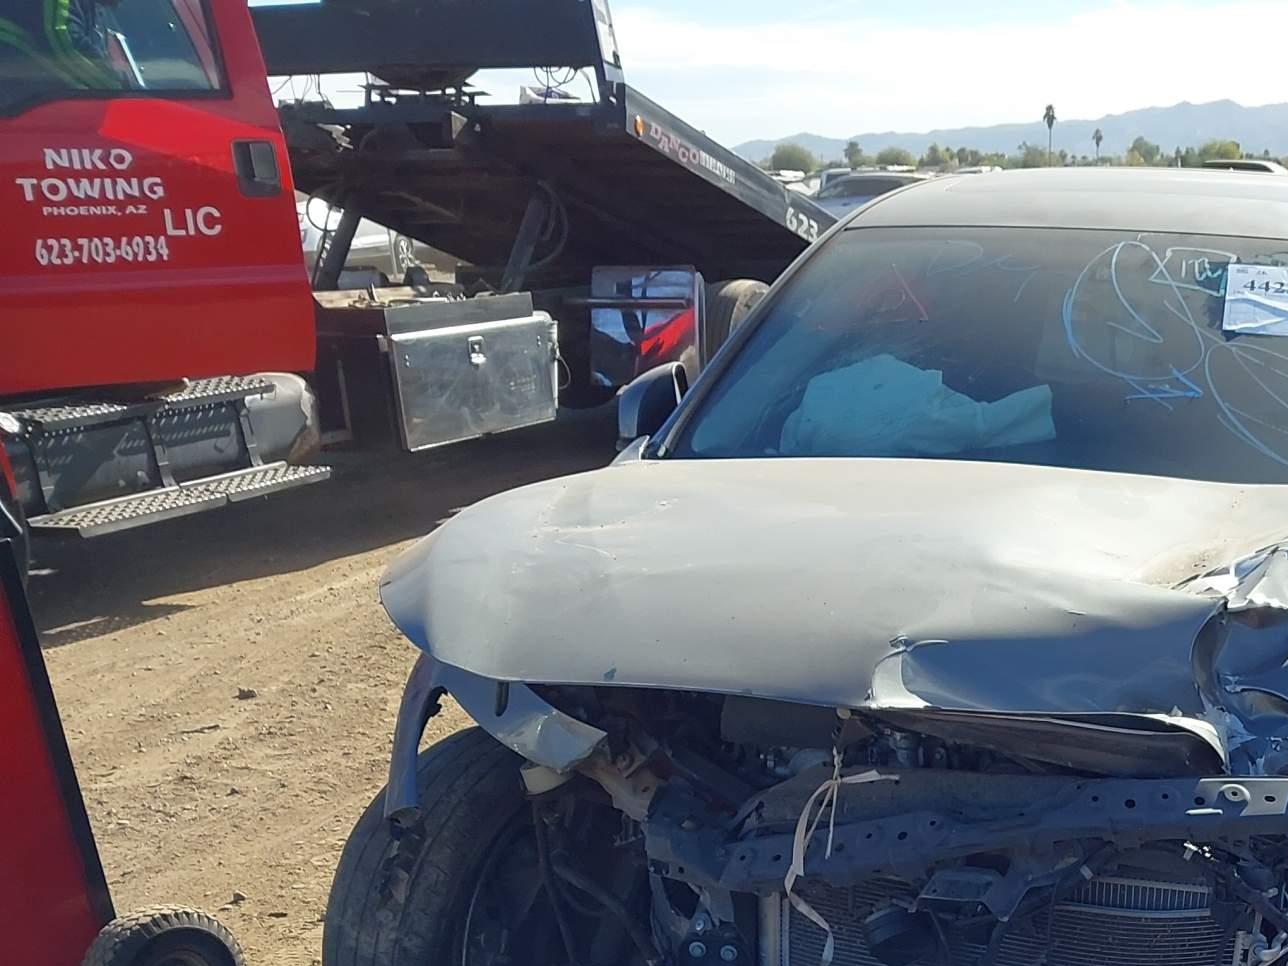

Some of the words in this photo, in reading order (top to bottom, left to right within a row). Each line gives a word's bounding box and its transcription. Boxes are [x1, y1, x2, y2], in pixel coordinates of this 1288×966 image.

[650, 122, 699, 164] DANCO
[43, 148, 133, 170] NIKO
[15, 177, 165, 202] TOWING
[42, 206, 122, 217] PHOENIX,
[125, 204, 147, 214] AZ
[164, 206, 222, 236] LIC
[786, 206, 818, 243] 623
[35, 235, 169, 266] 623-703-6934
